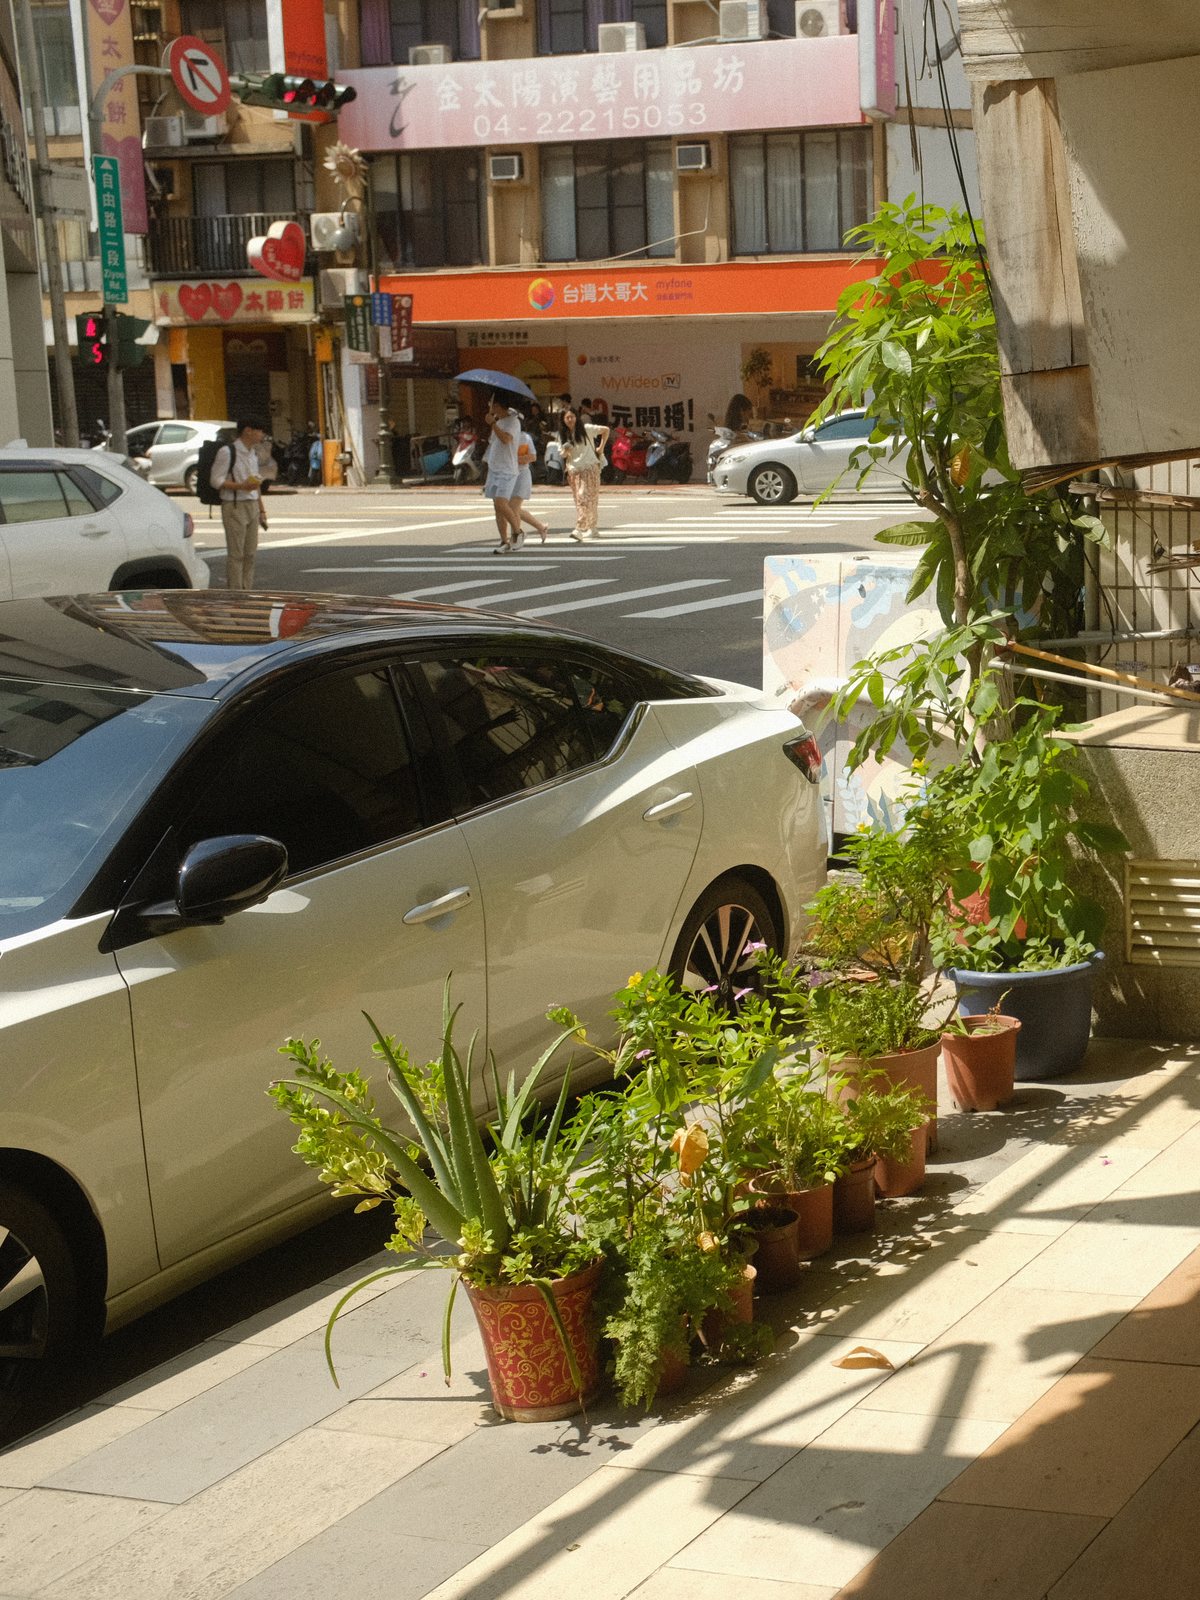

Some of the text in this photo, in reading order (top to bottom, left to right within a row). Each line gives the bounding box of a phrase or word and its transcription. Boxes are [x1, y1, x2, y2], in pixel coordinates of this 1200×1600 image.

[437, 55, 745, 111] 金太陽演藝用品坊
[474, 103, 707, 137] 04-22215053
[102, 173, 119, 266] 自由路二段
[104, 269, 125, 279] Ziyou
[656, 278, 692, 290] myfone
[244, 290, 304, 312] 太陽餅
[563, 282, 648, 303] 台灣大哥大
[91, 342, 103, 364] 5
[602, 375, 660, 391] MyVideo
